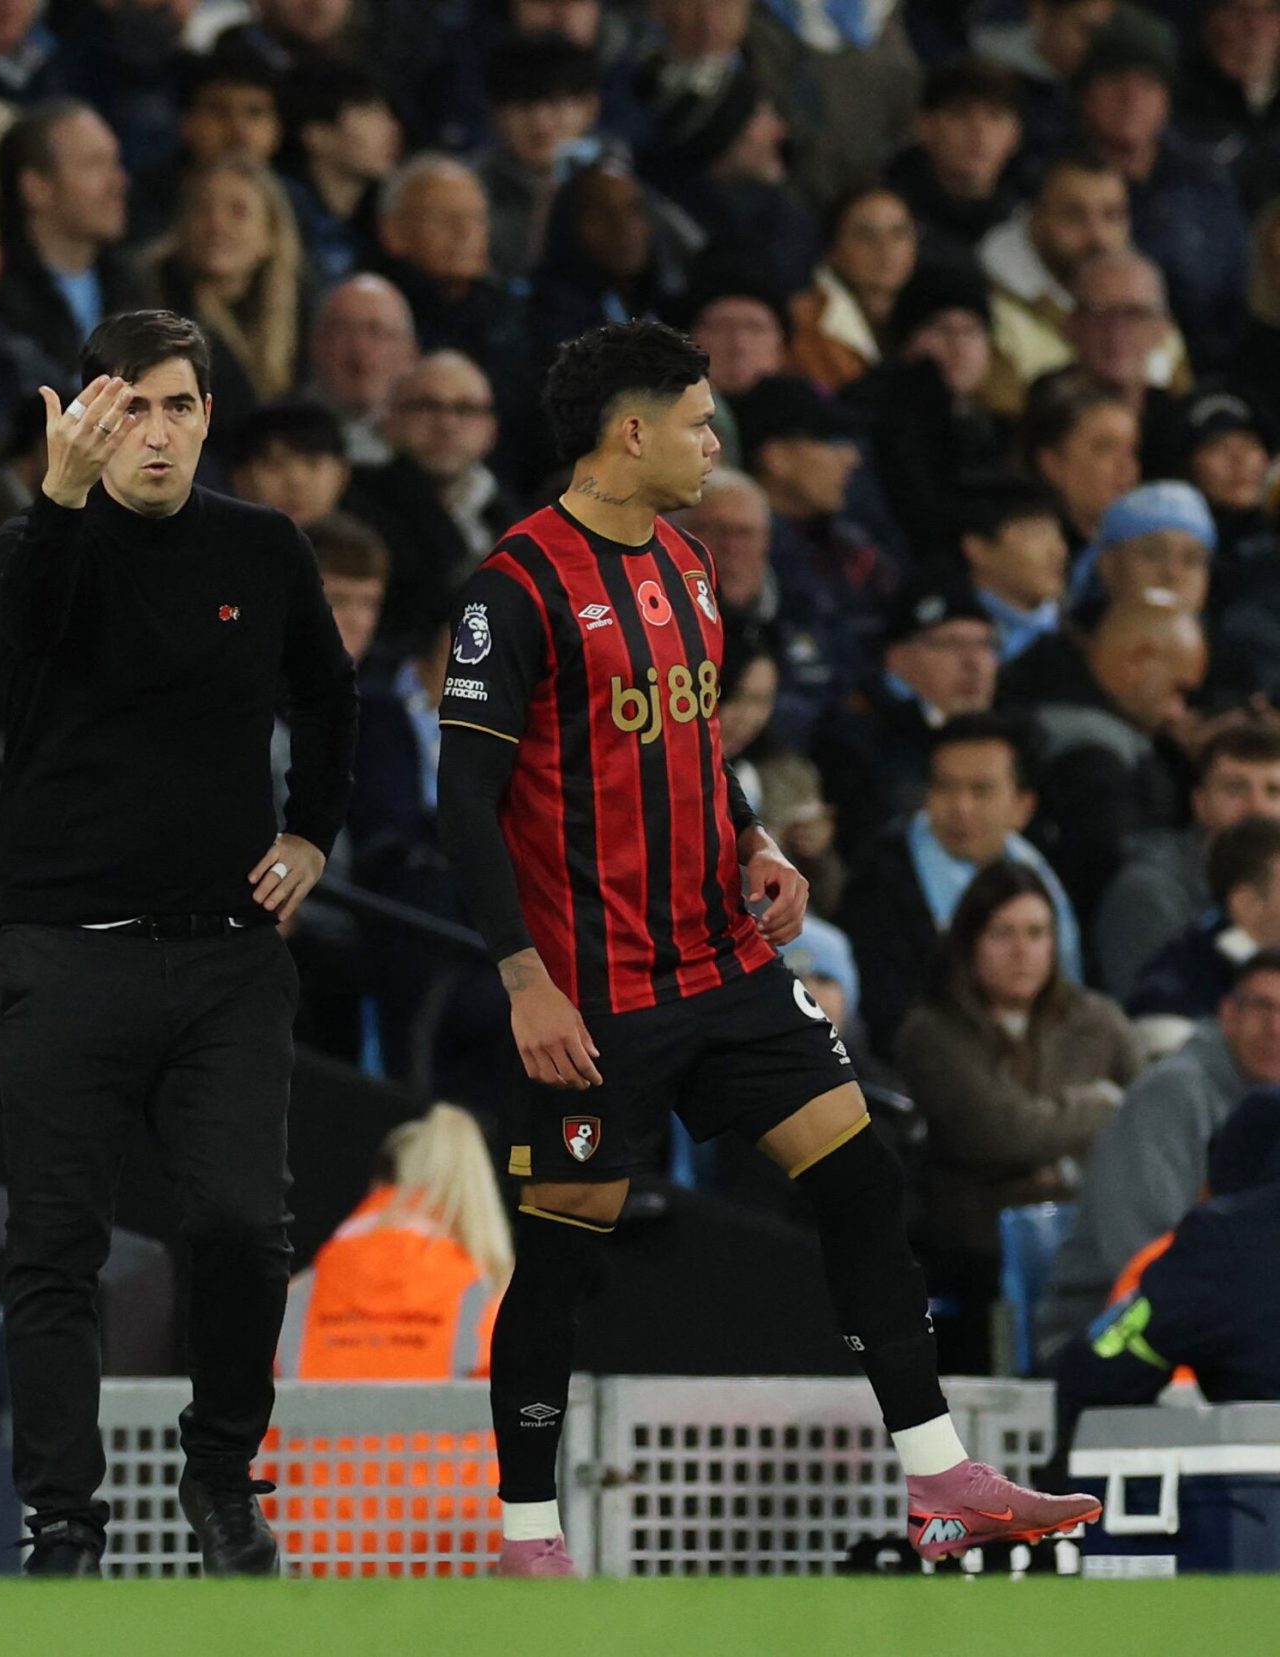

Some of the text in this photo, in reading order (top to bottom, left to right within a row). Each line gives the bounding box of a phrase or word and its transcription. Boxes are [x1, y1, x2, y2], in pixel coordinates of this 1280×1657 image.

[586, 618, 613, 631] umbro
[454, 678, 484, 691] room
[611, 660, 718, 744] bj88
